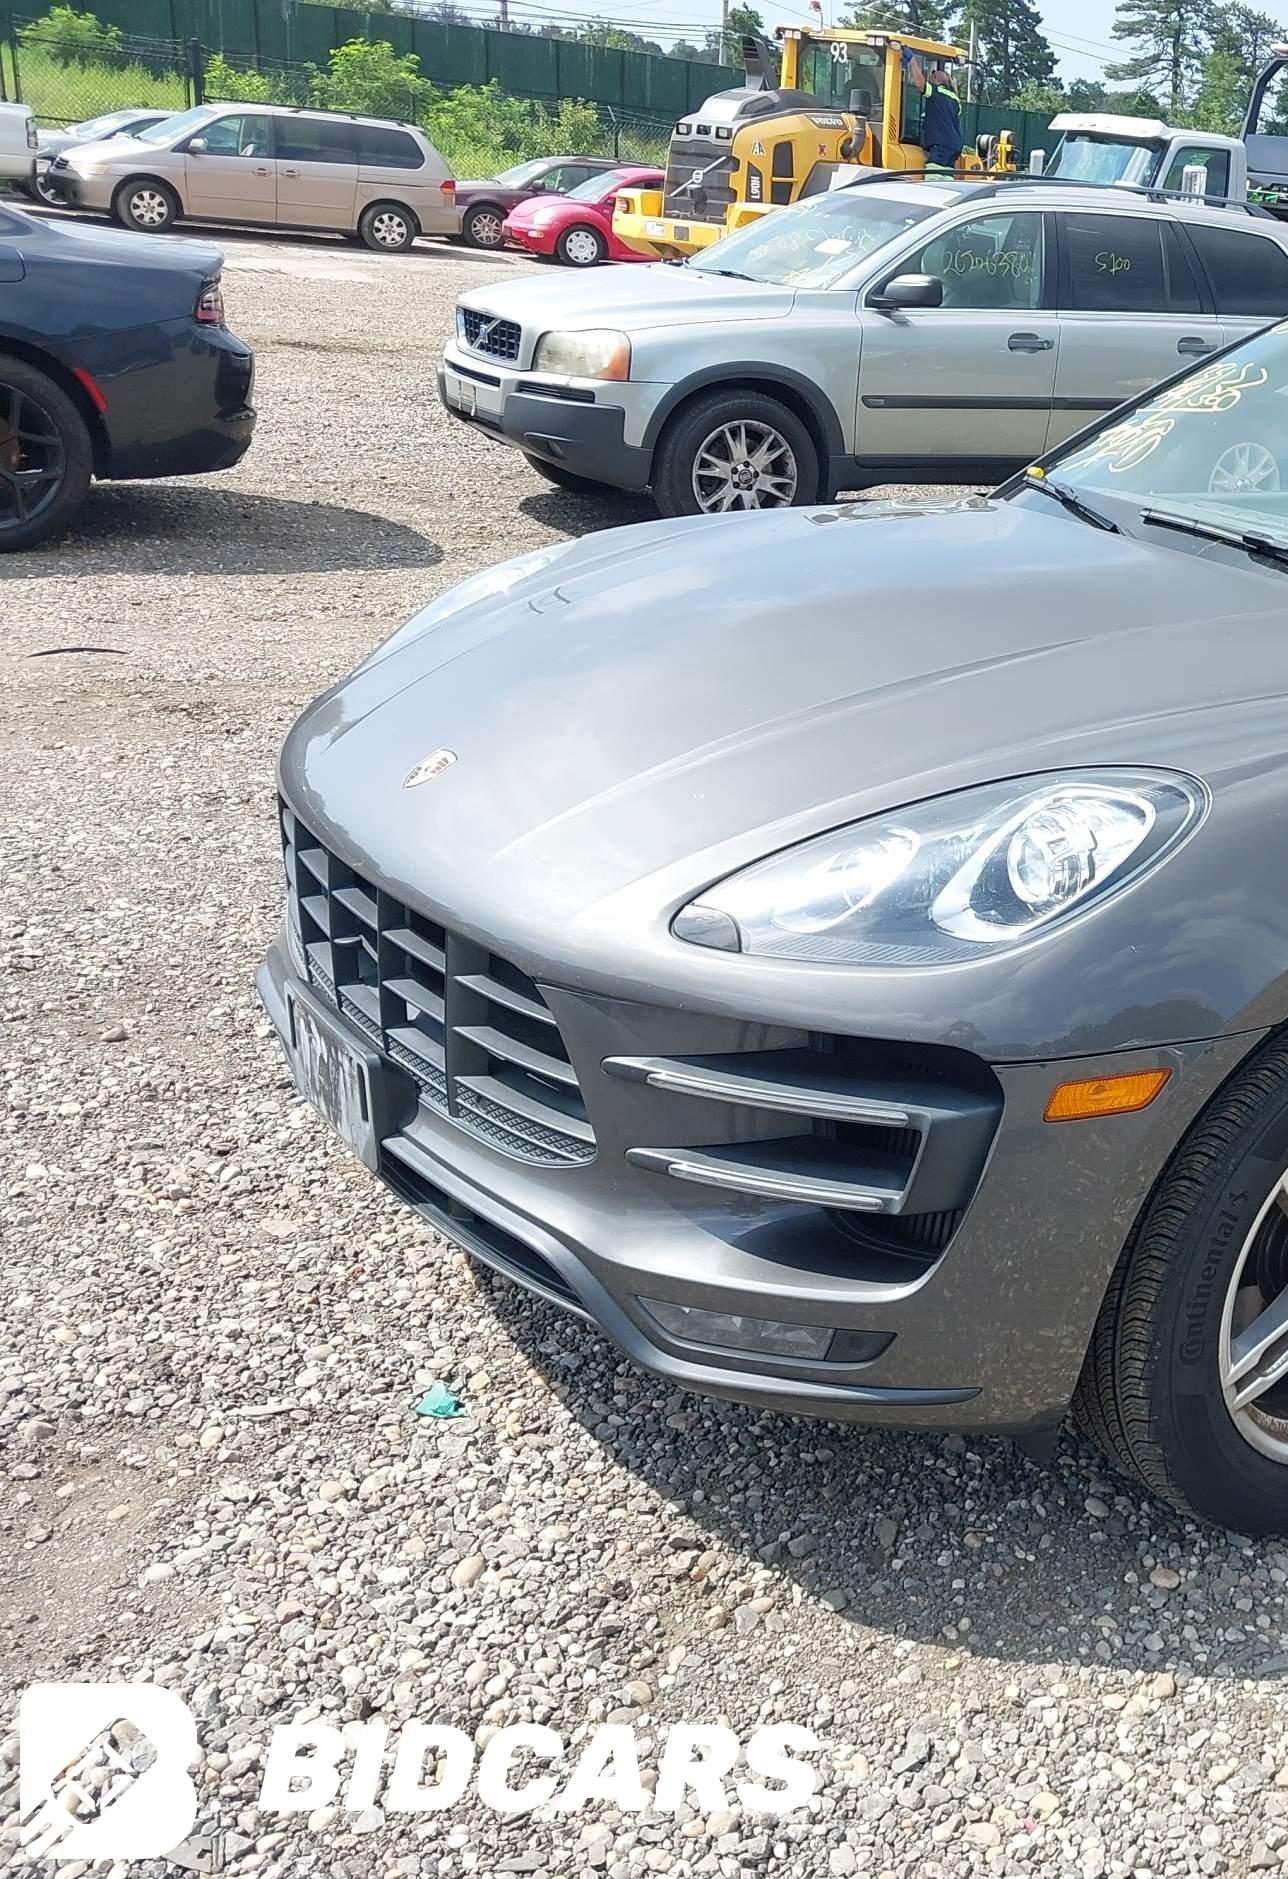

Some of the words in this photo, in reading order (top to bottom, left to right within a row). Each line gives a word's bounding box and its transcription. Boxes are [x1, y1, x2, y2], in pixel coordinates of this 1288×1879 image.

[830, 42, 849, 63] 93
[812, 117, 843, 126] VOLVO
[1179, 1208, 1241, 1365] Continental
